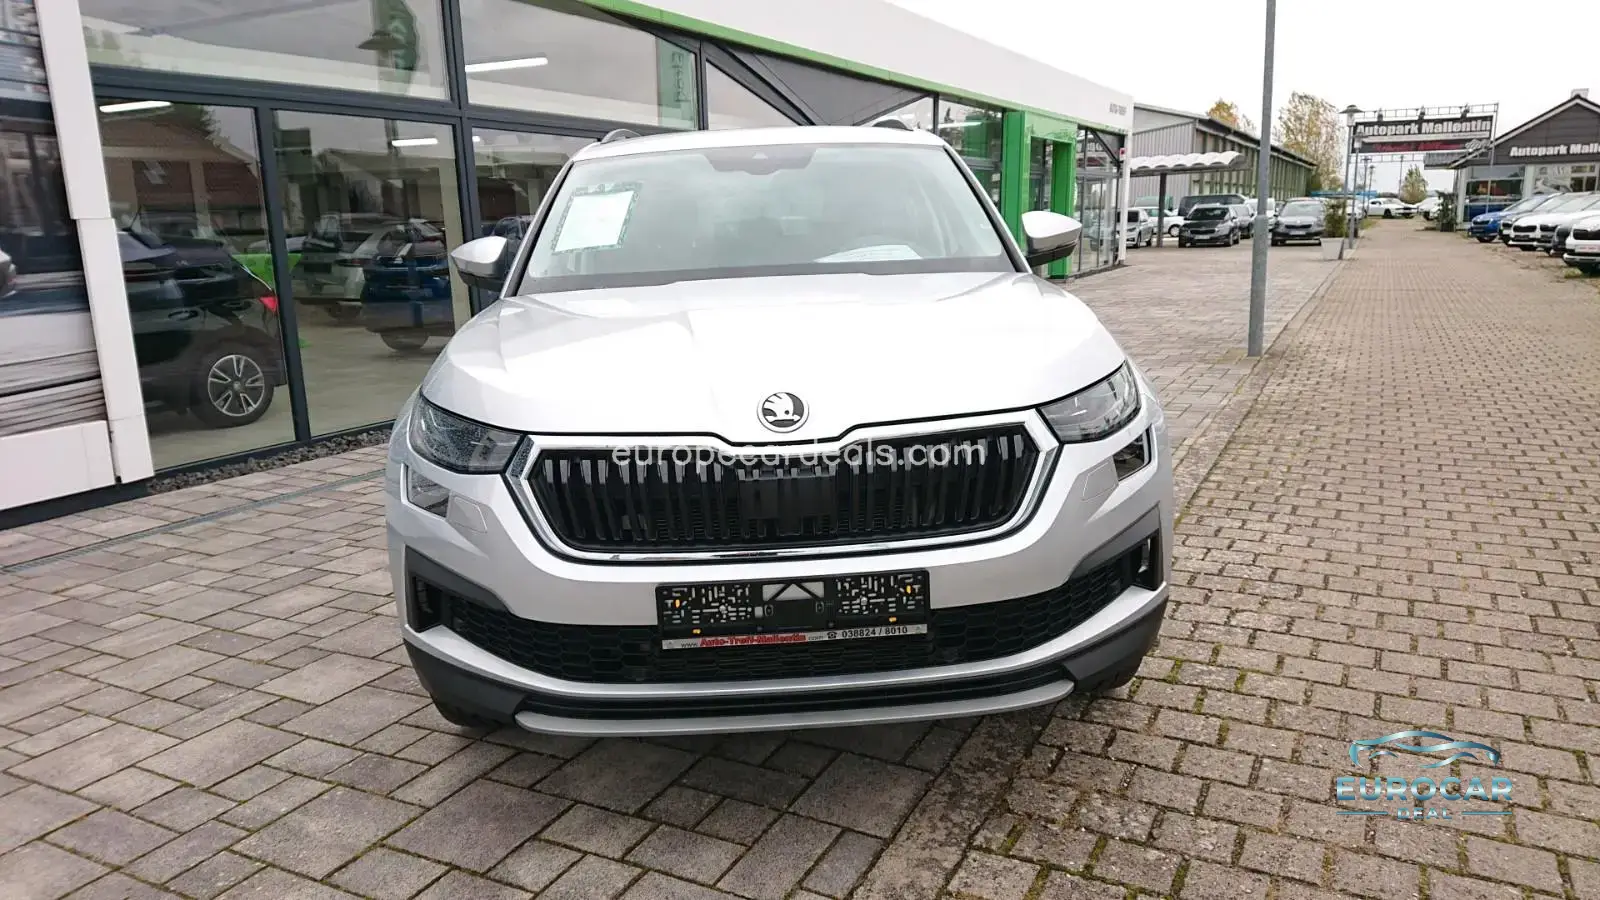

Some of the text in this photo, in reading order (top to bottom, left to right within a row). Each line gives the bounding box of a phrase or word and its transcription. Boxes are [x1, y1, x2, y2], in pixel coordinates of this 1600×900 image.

[1356, 120, 1491, 136] Autopark Mallentin
[1510, 144, 1568, 156] Autopark
[841, 627, 876, 638] 038824
[884, 626, 908, 635] 8010
